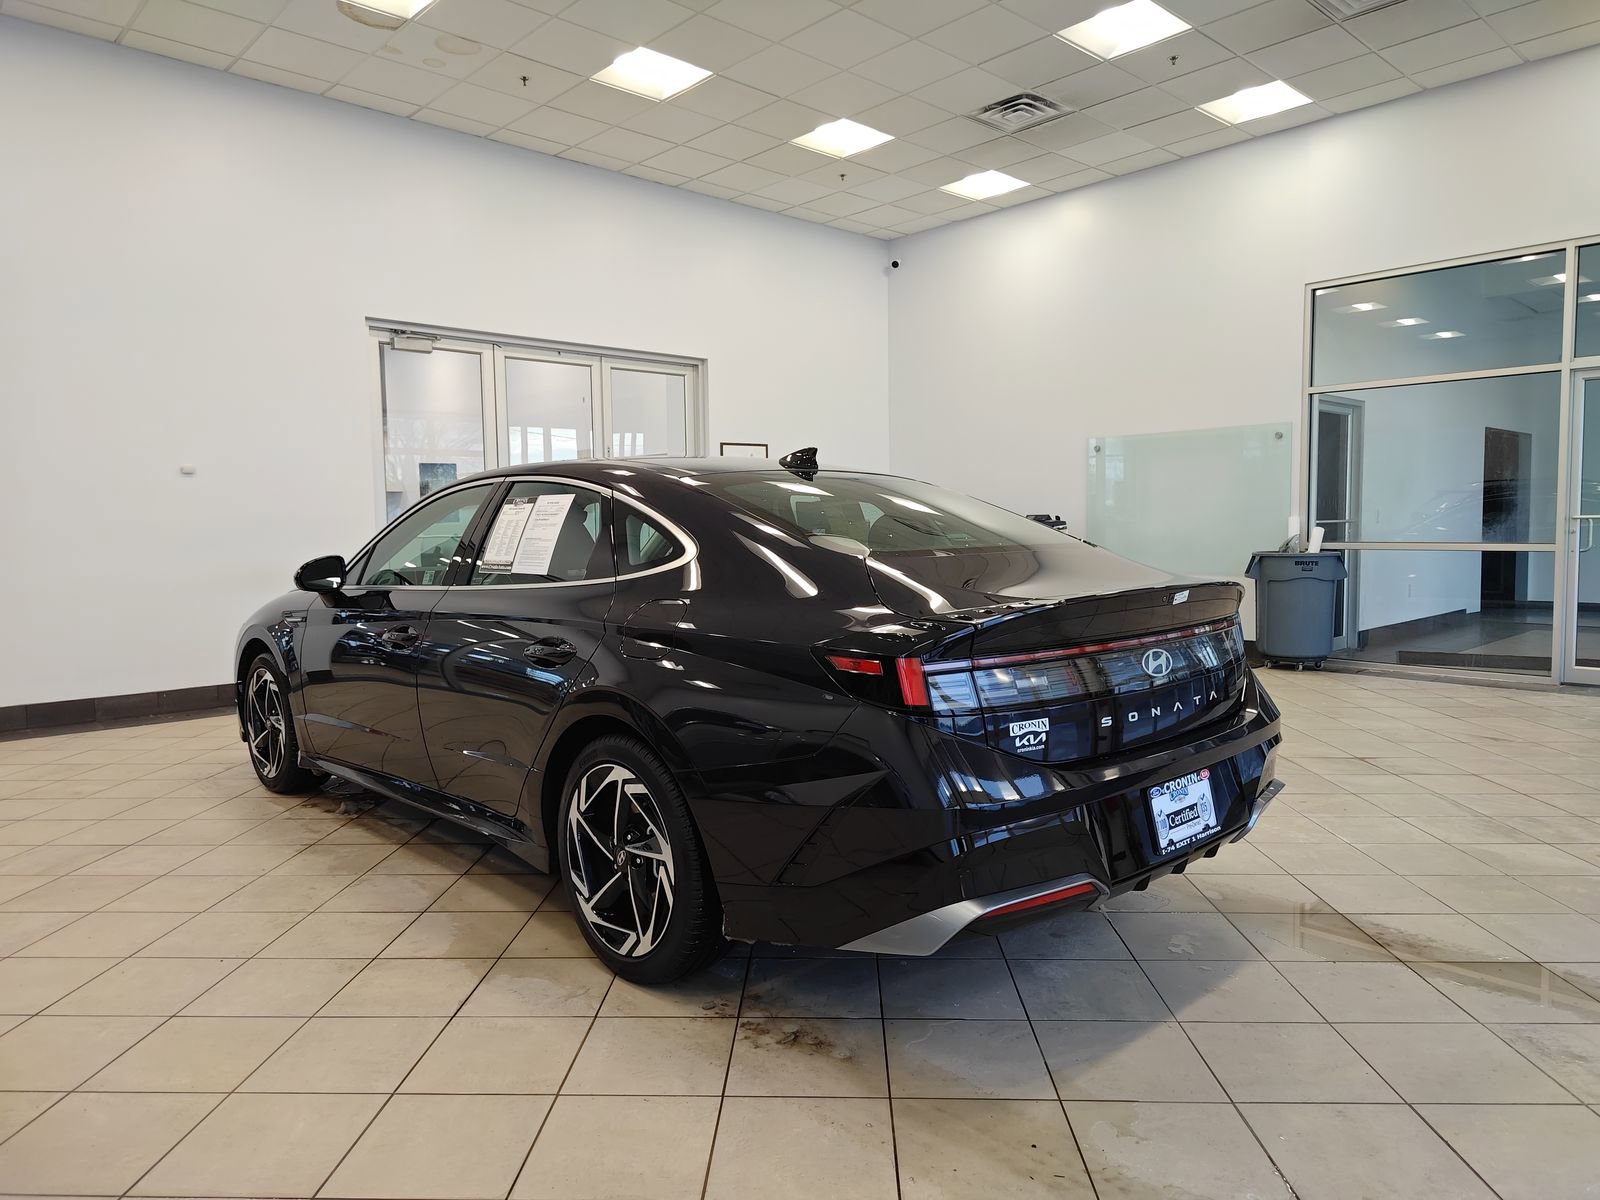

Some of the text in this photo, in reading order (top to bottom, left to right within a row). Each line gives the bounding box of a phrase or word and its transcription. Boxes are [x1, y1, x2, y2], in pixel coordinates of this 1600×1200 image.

[1101, 690, 1217, 727] SONATA
[1011, 719, 1048, 735] CRONIN
[1163, 772, 1198, 794] CRONIN
[1169, 807, 1199, 827] Certified
[1176, 837, 1191, 848] EXIT
[1197, 826, 1221, 839] Harrison
